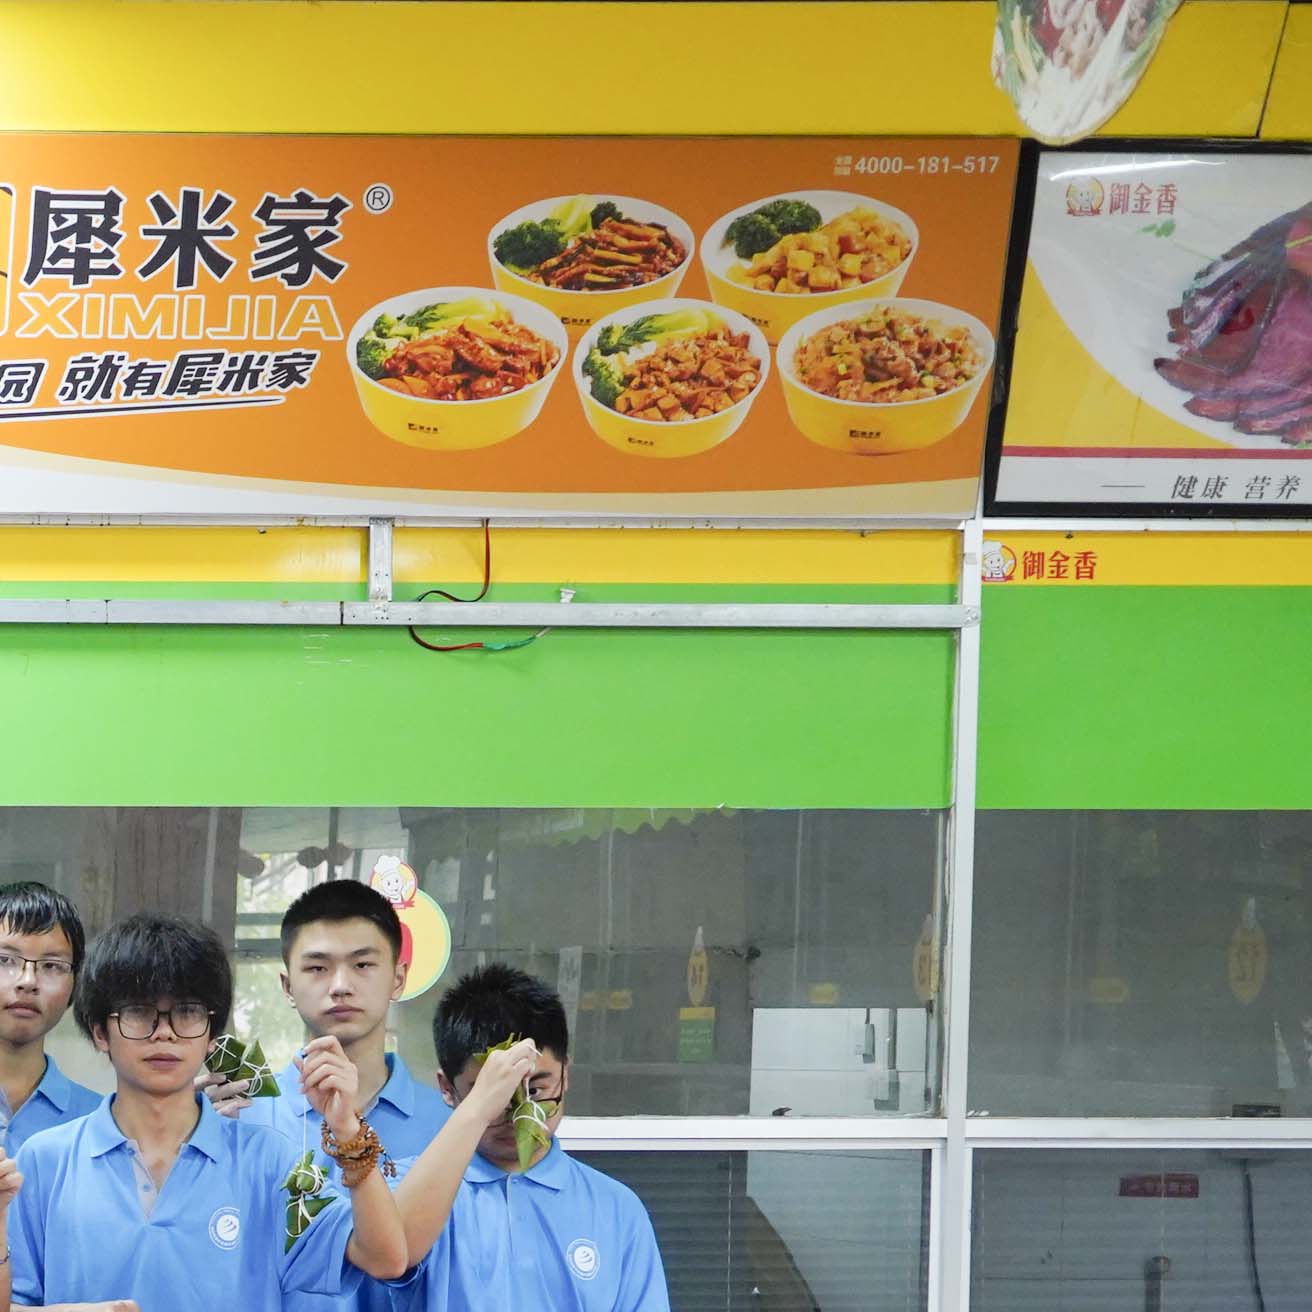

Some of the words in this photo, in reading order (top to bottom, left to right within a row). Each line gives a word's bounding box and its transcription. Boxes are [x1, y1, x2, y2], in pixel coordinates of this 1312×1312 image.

[855, 156, 1000, 173] 4000-181-517
[1106, 184, 1177, 215] 御金香
[25, 187, 352, 288] 犀米家
[16, 294, 343, 341] XIMIJIA
[59, 351, 320, 404] 就有犀米家
[1169, 476, 1228, 501] 健康
[1245, 476, 1300, 499] 营养
[1023, 550, 1095, 580] 御金香
